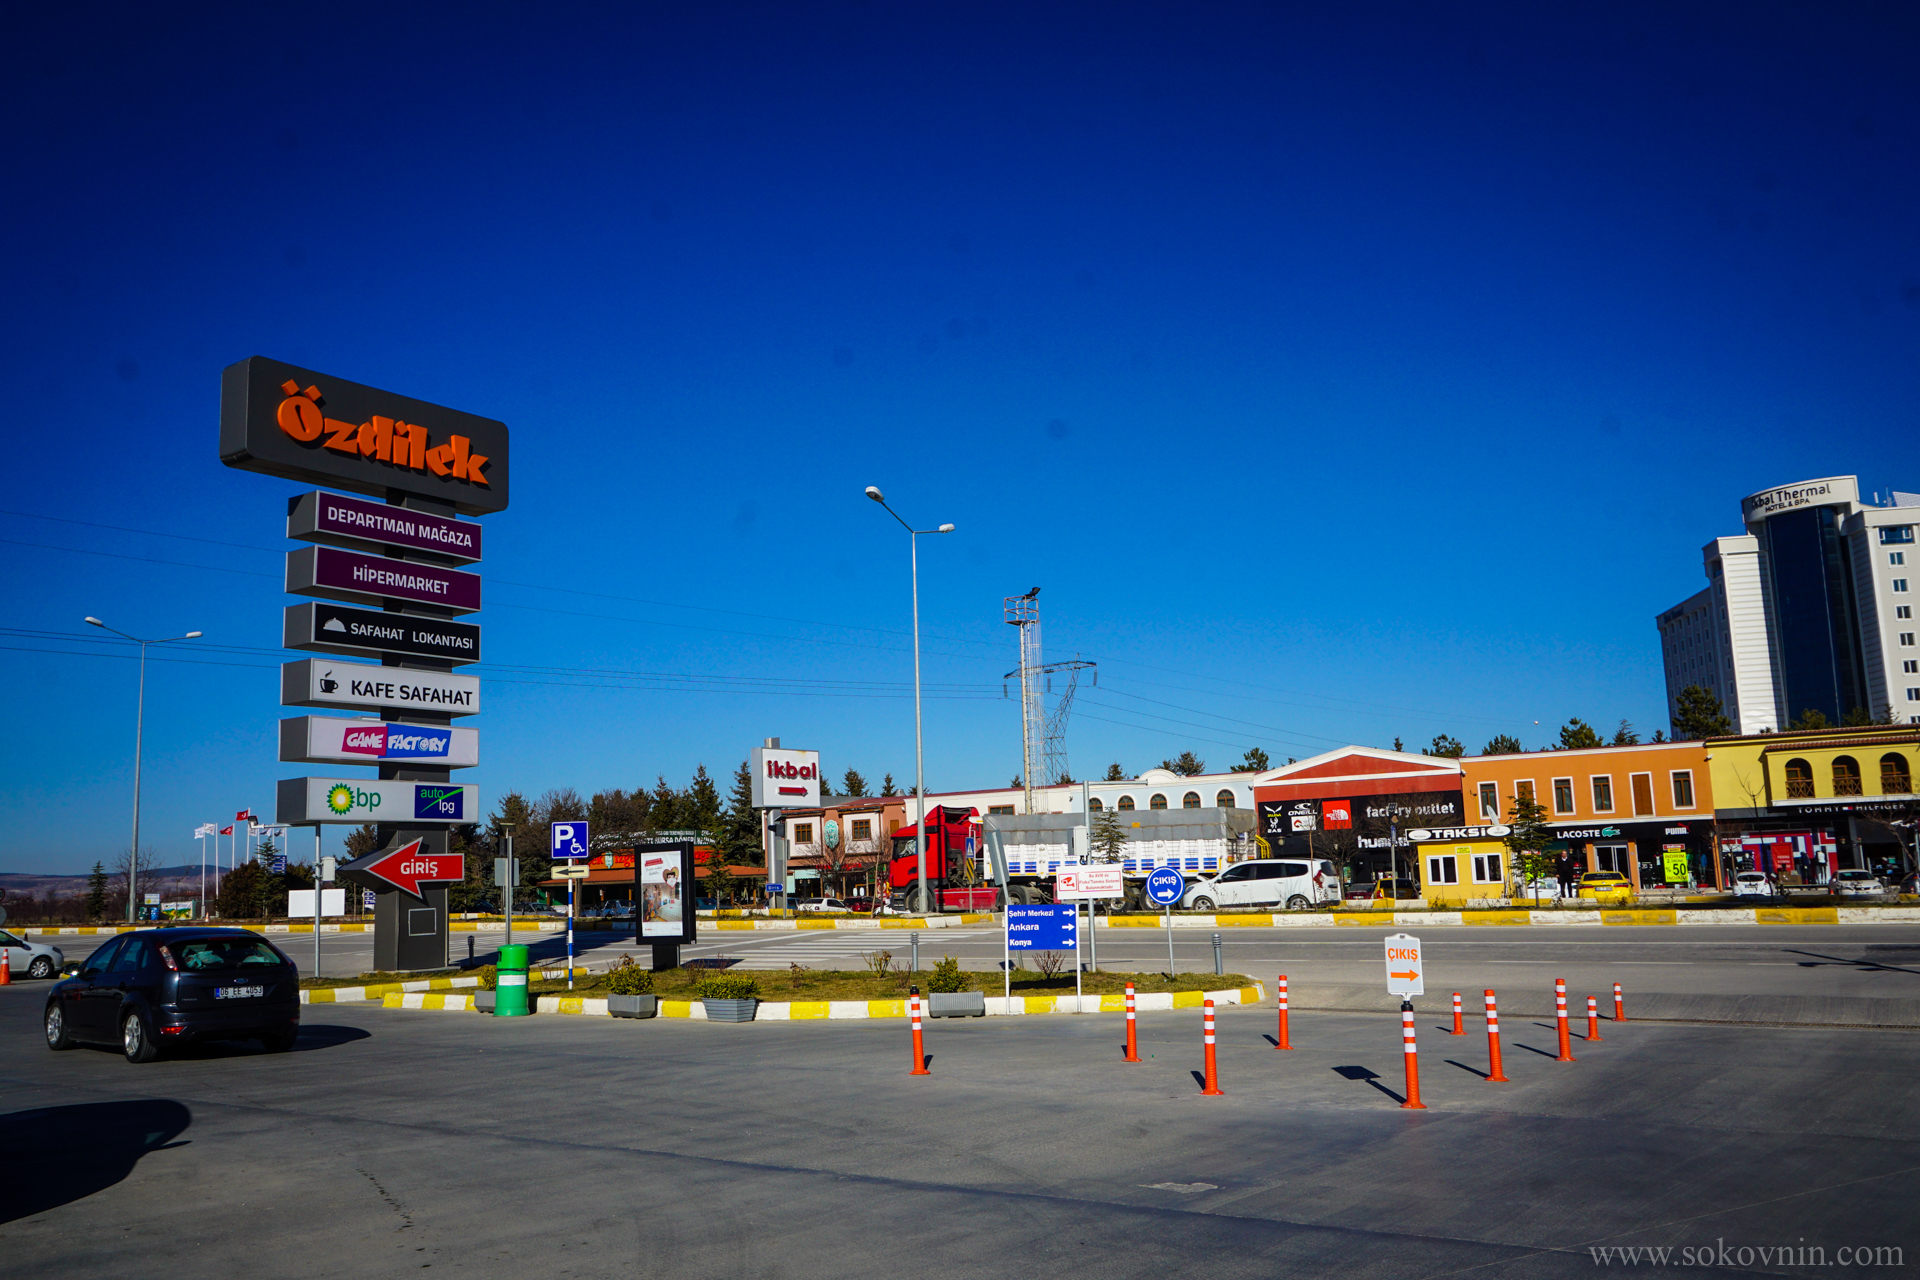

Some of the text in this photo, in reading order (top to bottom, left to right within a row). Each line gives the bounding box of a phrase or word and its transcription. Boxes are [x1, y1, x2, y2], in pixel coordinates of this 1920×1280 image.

[277, 378, 489, 485] Özdilek
[1776, 483, 1832, 502] Thermal
[1765, 502, 1788, 513] HOTEL
[1794, 498, 1811, 506] SPA
[327, 506, 473, 548] DEPARTMAN MAĞAZA
[353, 564, 450, 595] HİPERMARKET
[350, 622, 473, 649] SAFAHAT LOKANTASI
[351, 679, 473, 706] KAFE SAFAHAT
[346, 732, 447, 752] GAME FACTORY
[766, 760, 817, 779] ikbal
[356, 787, 382, 812] bp
[420, 788, 444, 799] auto
[439, 799, 455, 814] lpg
[1414, 802, 1455, 815] outlet
[1797, 802, 1906, 814] TOMMY HILFIGER
[554, 825, 574, 849] P
[1556, 829, 1601, 839] LACOSTE
[1665, 827, 1687, 835] PUMA
[400, 858, 439, 877] GİRİŞ
[1152, 876, 1177, 886] ÇIKIŞ
[1008, 909, 1054, 918] Şehir Merkezi
[1009, 923, 1040, 931] Ankara
[1009, 939, 1032, 947] Konya
[1387, 947, 1418, 962] ÇIKIŞ
[220, 988, 229, 996] 06
